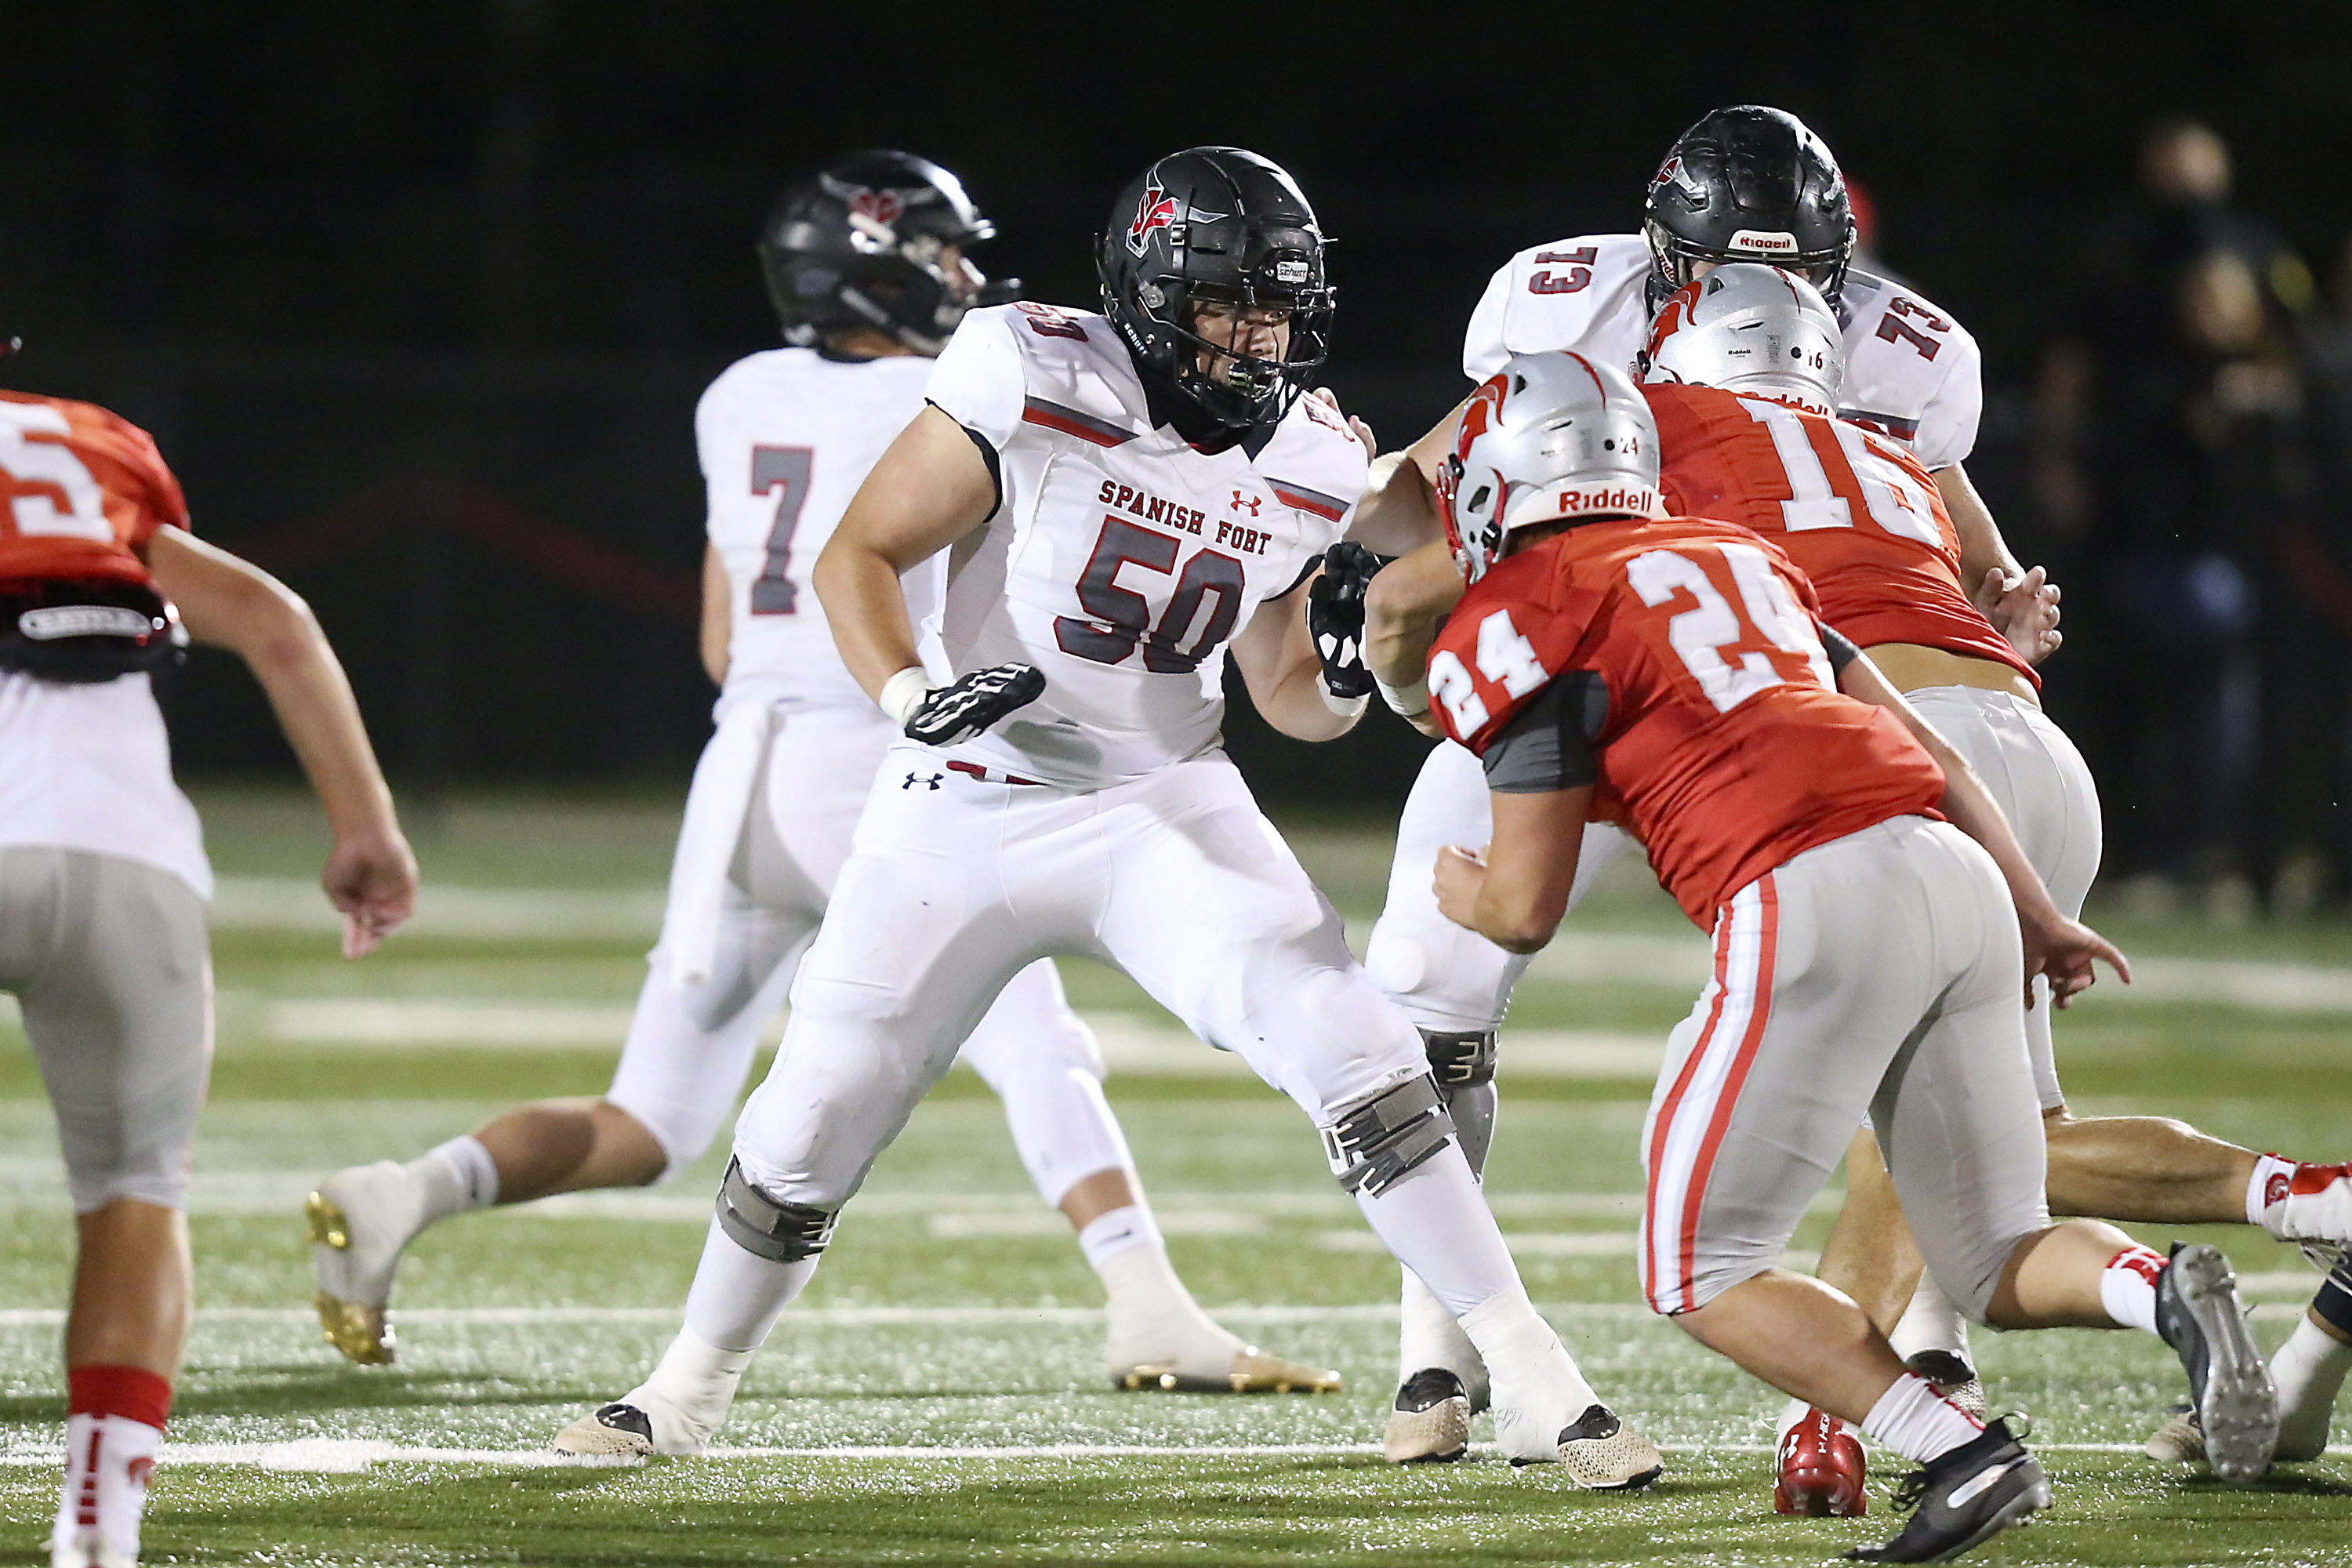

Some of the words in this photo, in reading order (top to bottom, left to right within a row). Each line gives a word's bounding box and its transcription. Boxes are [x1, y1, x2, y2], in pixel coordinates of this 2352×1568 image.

[1279, 267, 1306, 277] schutt
[1527, 246, 1599, 295] 73
[1740, 236, 1791, 249] Riddell
[1807, 349, 1824, 369] 16
[1875, 297, 1951, 362] 73
[1559, 488, 1652, 513] Riddell
[1736, 397, 1943, 549] 16
[751, 445, 814, 615] 7
[1098, 480, 1206, 536] SPANISH
[1215, 521, 1272, 555] FORT
[1053, 514, 1246, 673] 50
[1625, 542, 1837, 713] 24
[1428, 608, 1550, 740] 24
